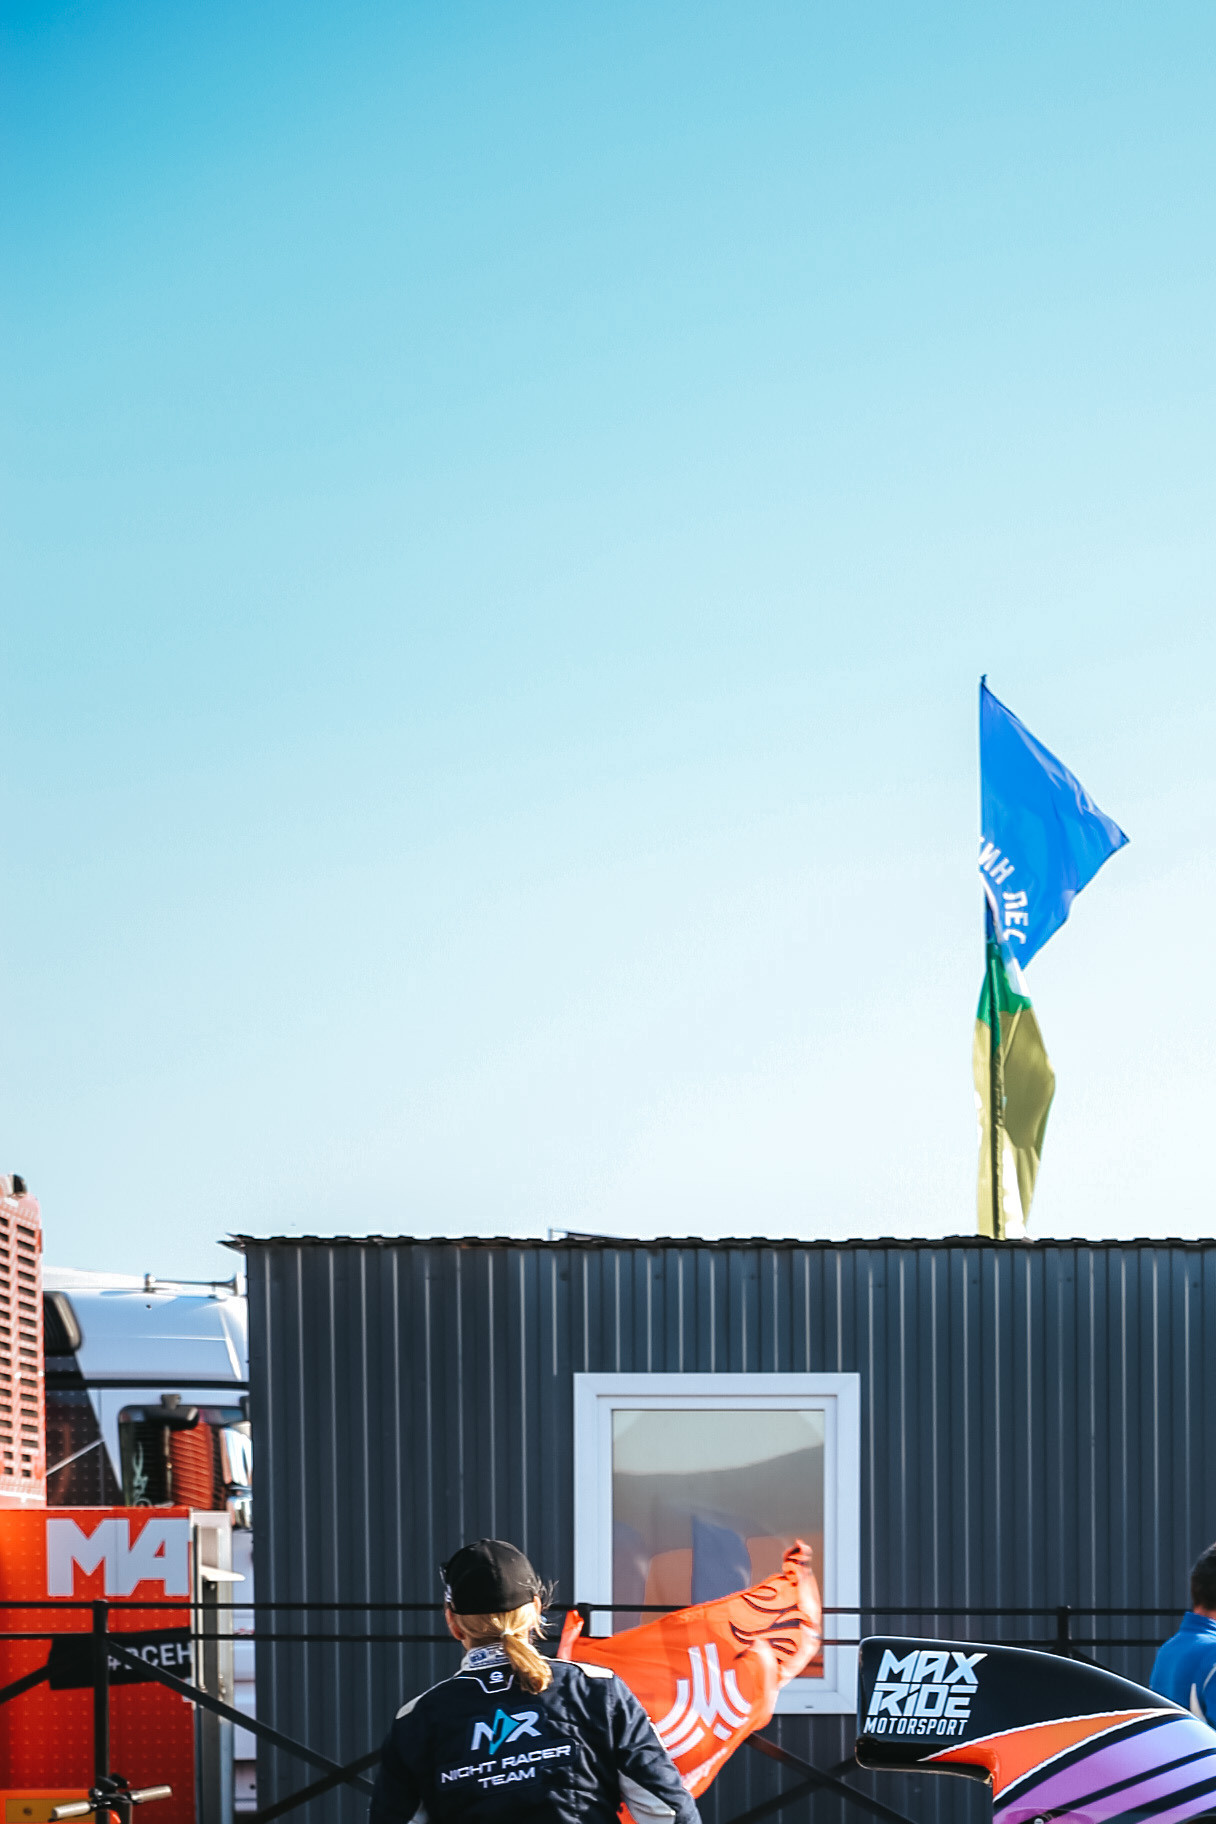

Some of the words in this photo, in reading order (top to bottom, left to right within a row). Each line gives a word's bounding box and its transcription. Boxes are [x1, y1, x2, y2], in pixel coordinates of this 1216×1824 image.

[1002, 890, 1029, 944] ЛЕС
[876, 1649, 988, 1684] MAX
[863, 1717, 968, 1735] MOTORSPORT
[441, 1761, 497, 1783] NIGHT
[501, 1745, 571, 1769] RACER
[477, 1767, 536, 1788] TEAM
